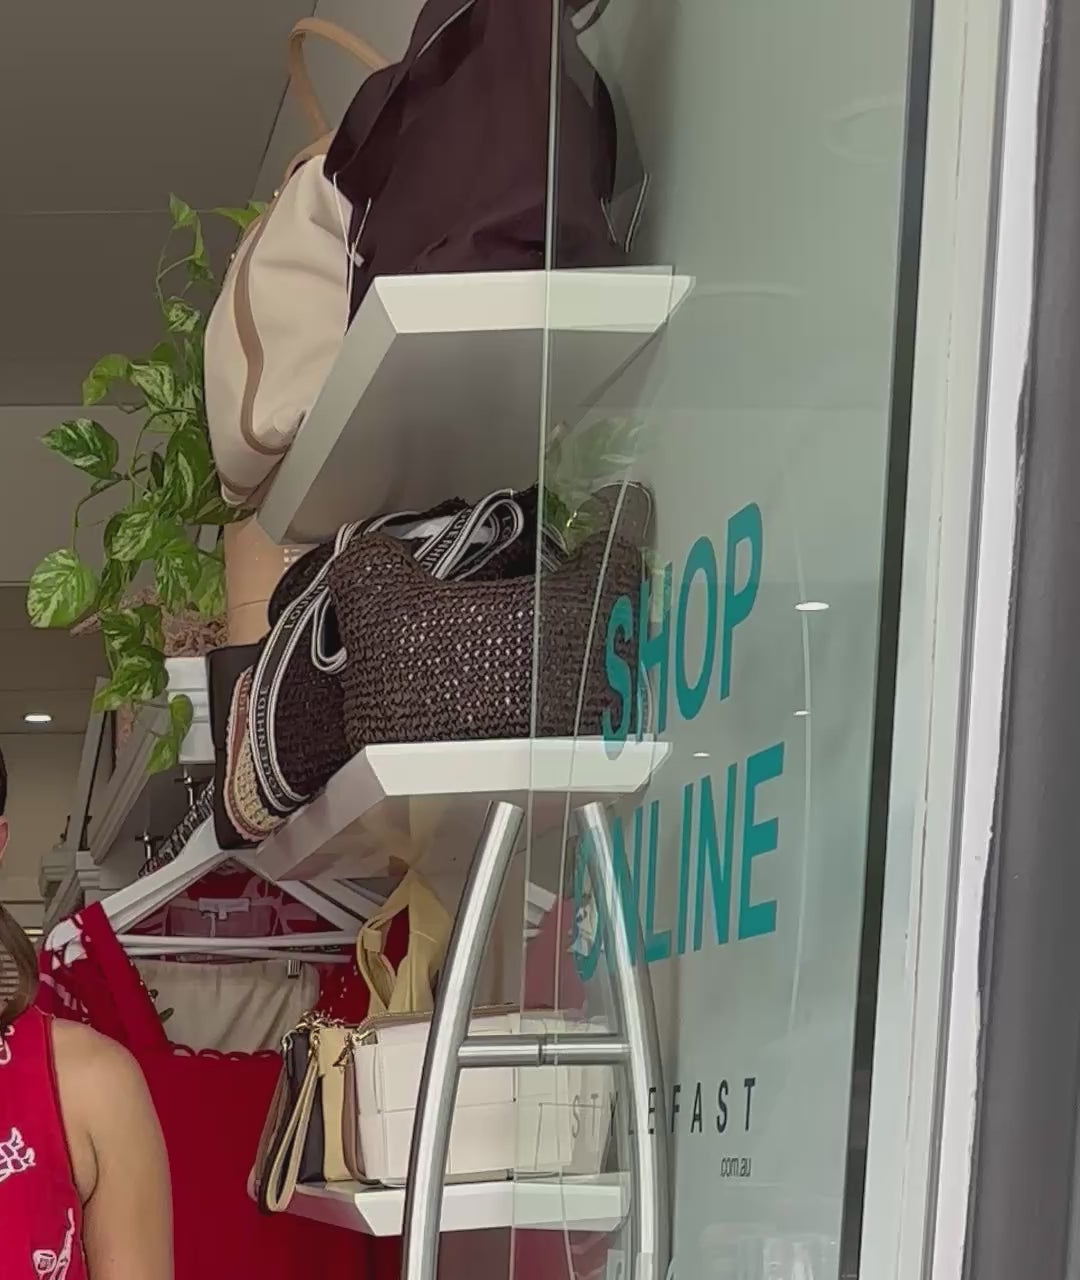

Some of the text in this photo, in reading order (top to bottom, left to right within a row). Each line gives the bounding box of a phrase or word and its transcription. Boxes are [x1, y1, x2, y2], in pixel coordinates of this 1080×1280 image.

[602, 502, 764, 761] SHOP
[573, 741, 785, 982] ONLINE
[572, 1077, 757, 1139] STYLEFAST
